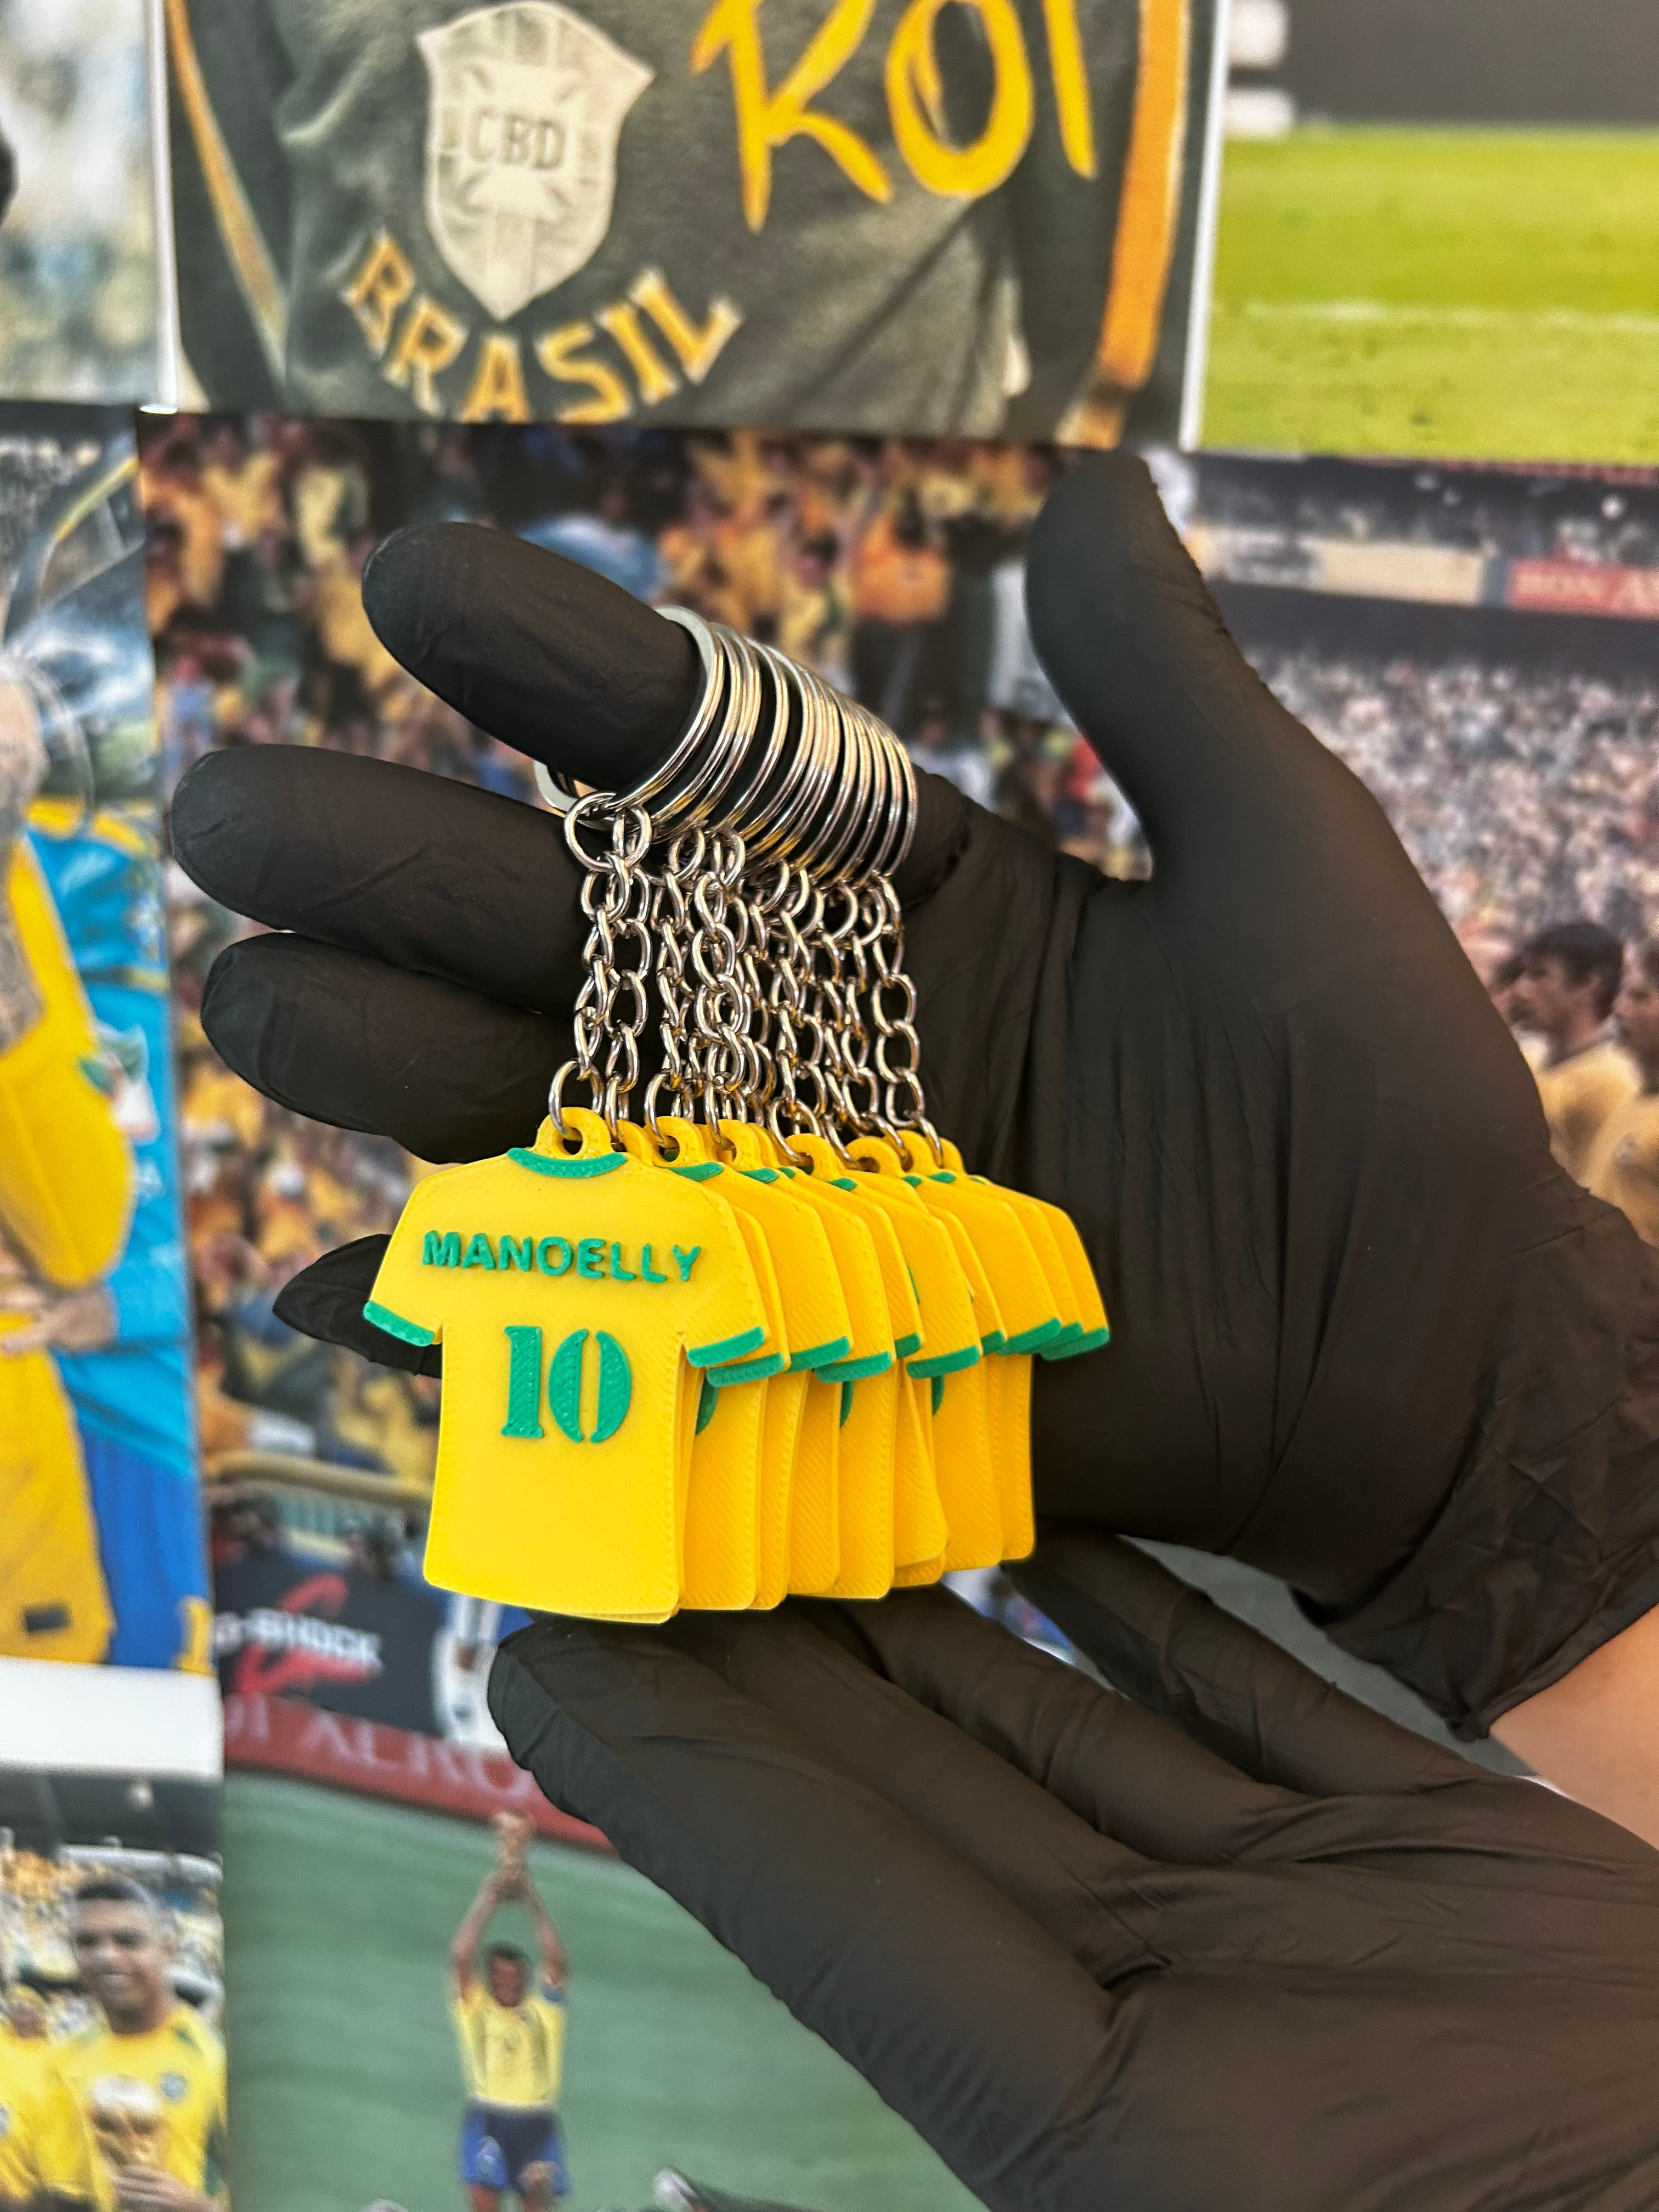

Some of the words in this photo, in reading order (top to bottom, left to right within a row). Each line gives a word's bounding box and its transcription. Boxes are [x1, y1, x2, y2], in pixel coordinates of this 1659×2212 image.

[467, 105, 567, 171] CBD
[341, 229, 742, 424] BRASIL
[422, 1231, 702, 1284] MANOELLY
[500, 1325, 632, 1443] 10
